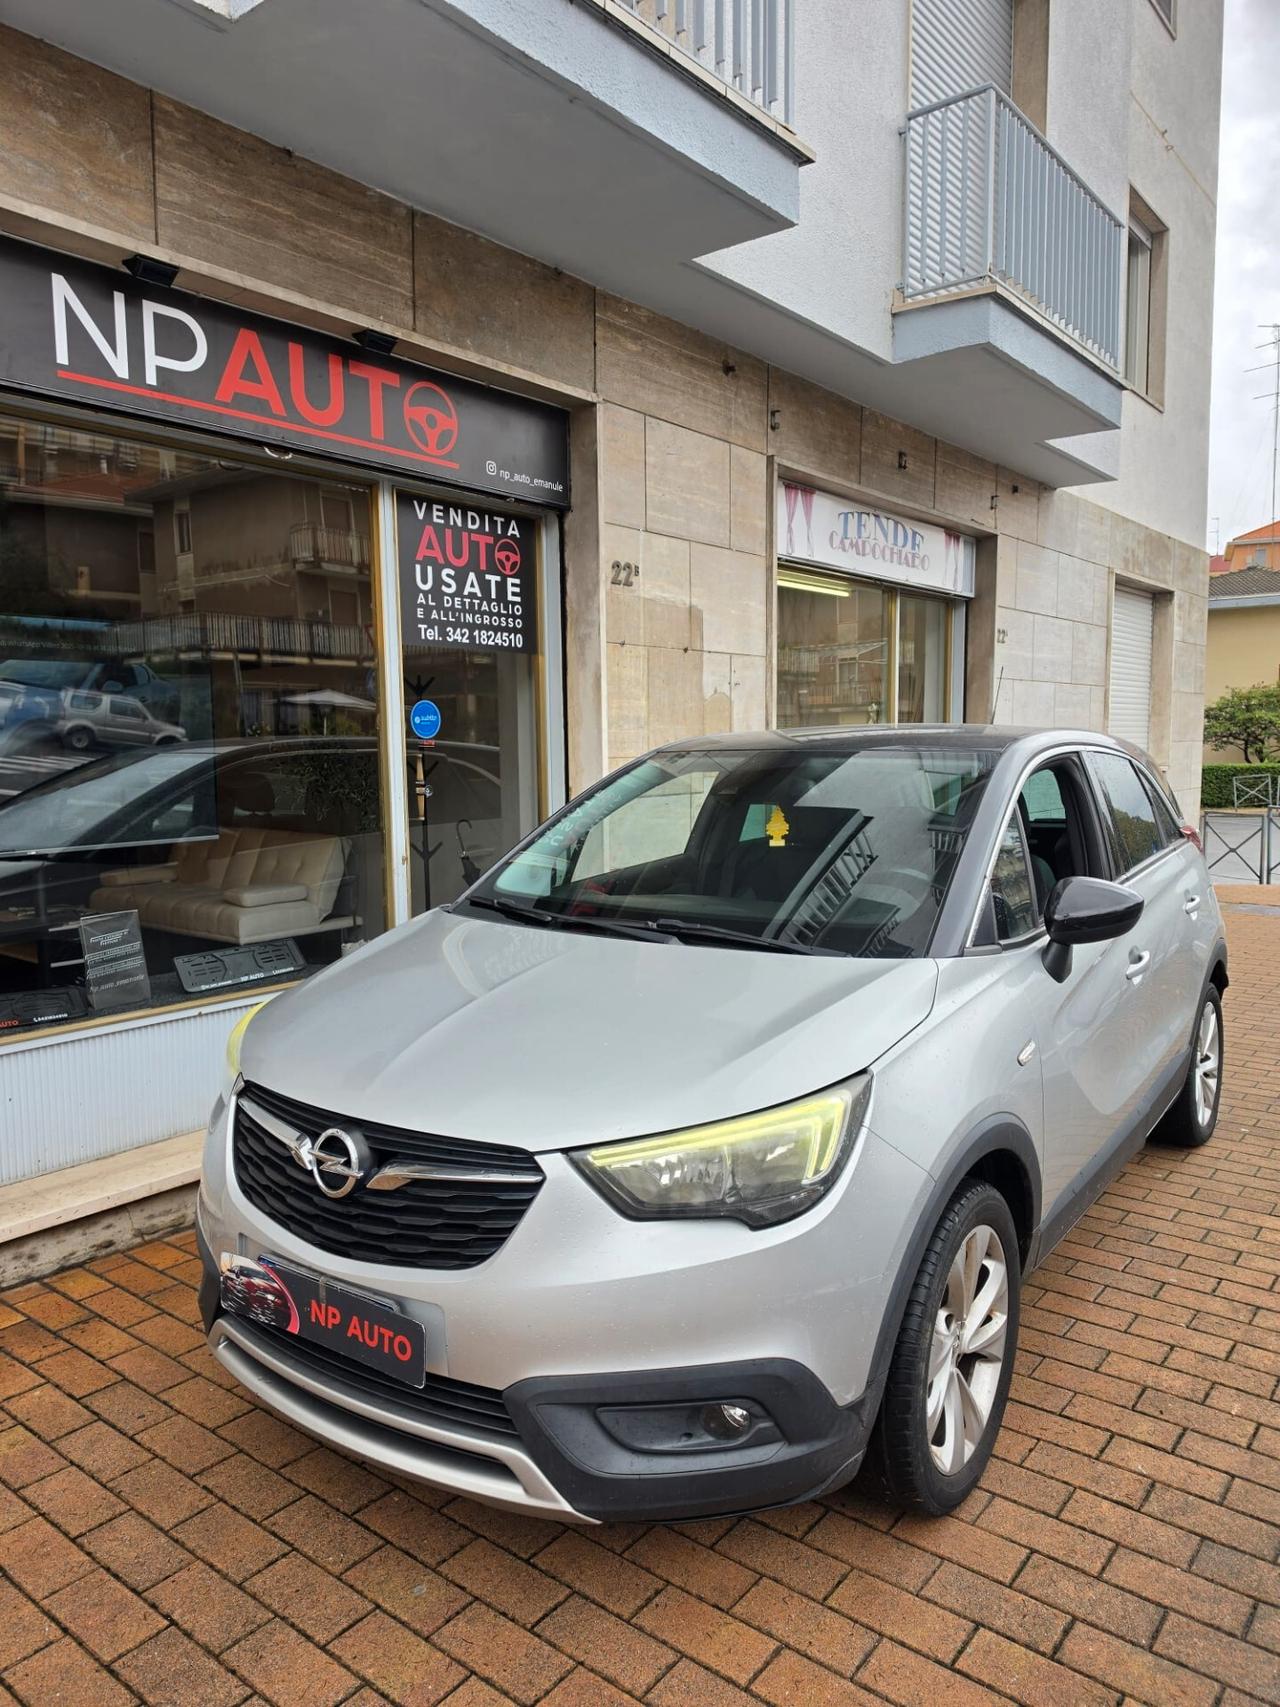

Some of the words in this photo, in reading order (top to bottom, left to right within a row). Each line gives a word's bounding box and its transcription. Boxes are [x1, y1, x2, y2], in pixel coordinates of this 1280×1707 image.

[52, 272, 207, 386] NP
[499, 469, 564, 492] np_auto_emanule
[413, 500, 521, 538] VENDITA
[837, 511, 925, 552] TENDE
[415, 525, 521, 576] AUTO
[415, 564, 522, 603] USATE
[416, 593, 436, 606] AL
[444, 596, 522, 616] DETTAGLIO
[417, 608, 424, 619] E
[431, 610, 523, 629] ALL'INGROSSO
[418, 624, 442, 641] Tel.
[446, 627, 470, 644] 342
[473, 629, 524, 648] 1824510
[309, 1299, 342, 1330] NP
[346, 1315, 413, 1362] AUTO
